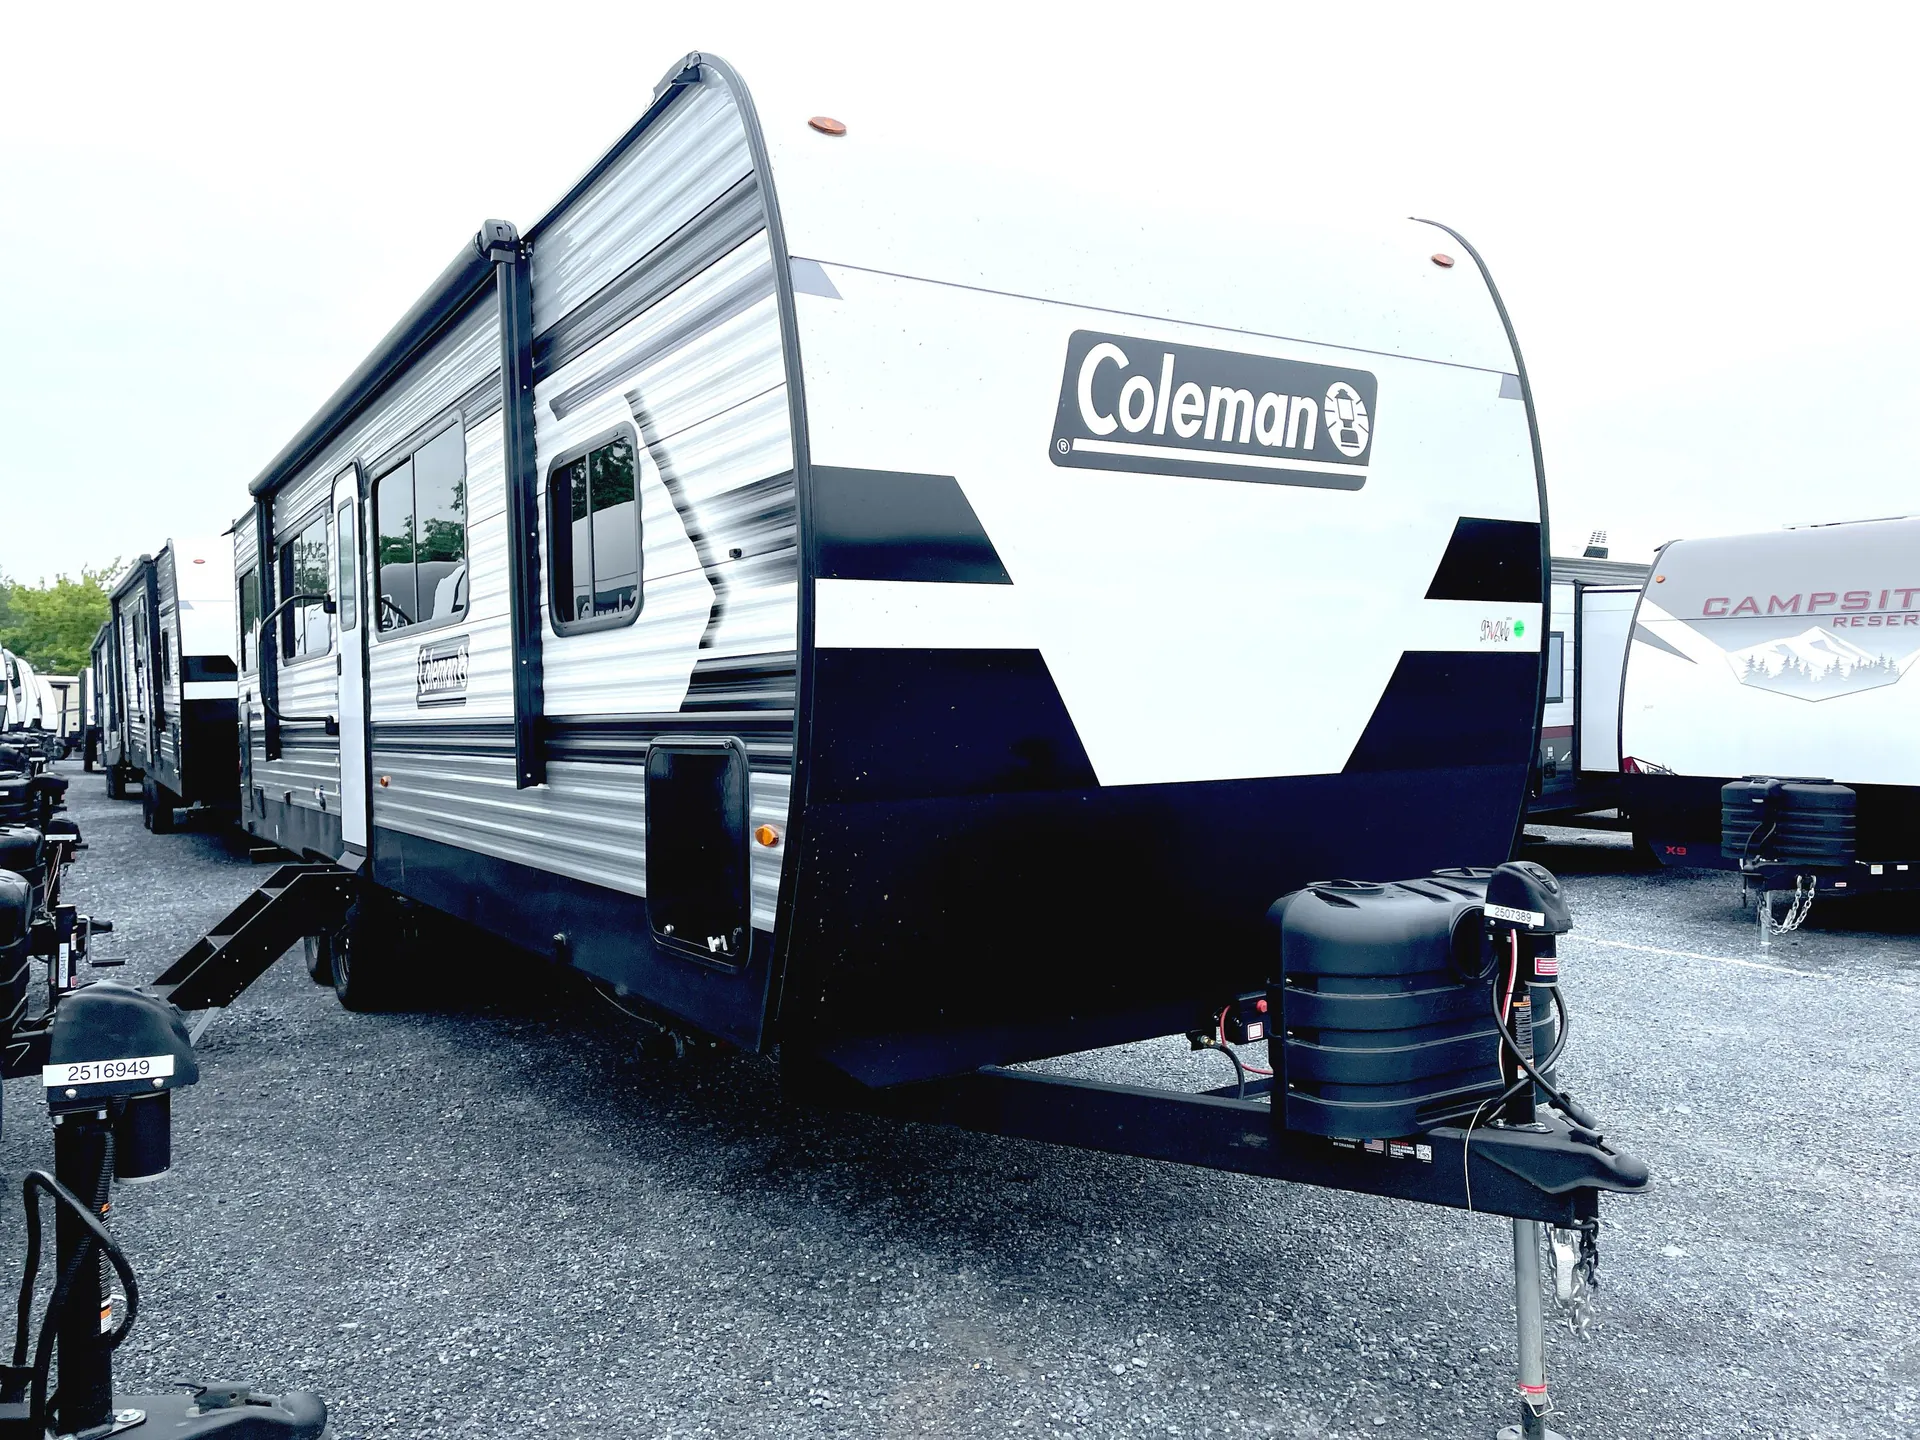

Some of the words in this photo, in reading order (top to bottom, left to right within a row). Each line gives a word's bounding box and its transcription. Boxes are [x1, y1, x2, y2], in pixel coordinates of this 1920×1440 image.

[1077, 342, 1319, 451] Coleman
[1665, 845, 1687, 856] X9
[1494, 906, 1532, 923] 2507389
[67, 1059, 150, 1081] 2516949
